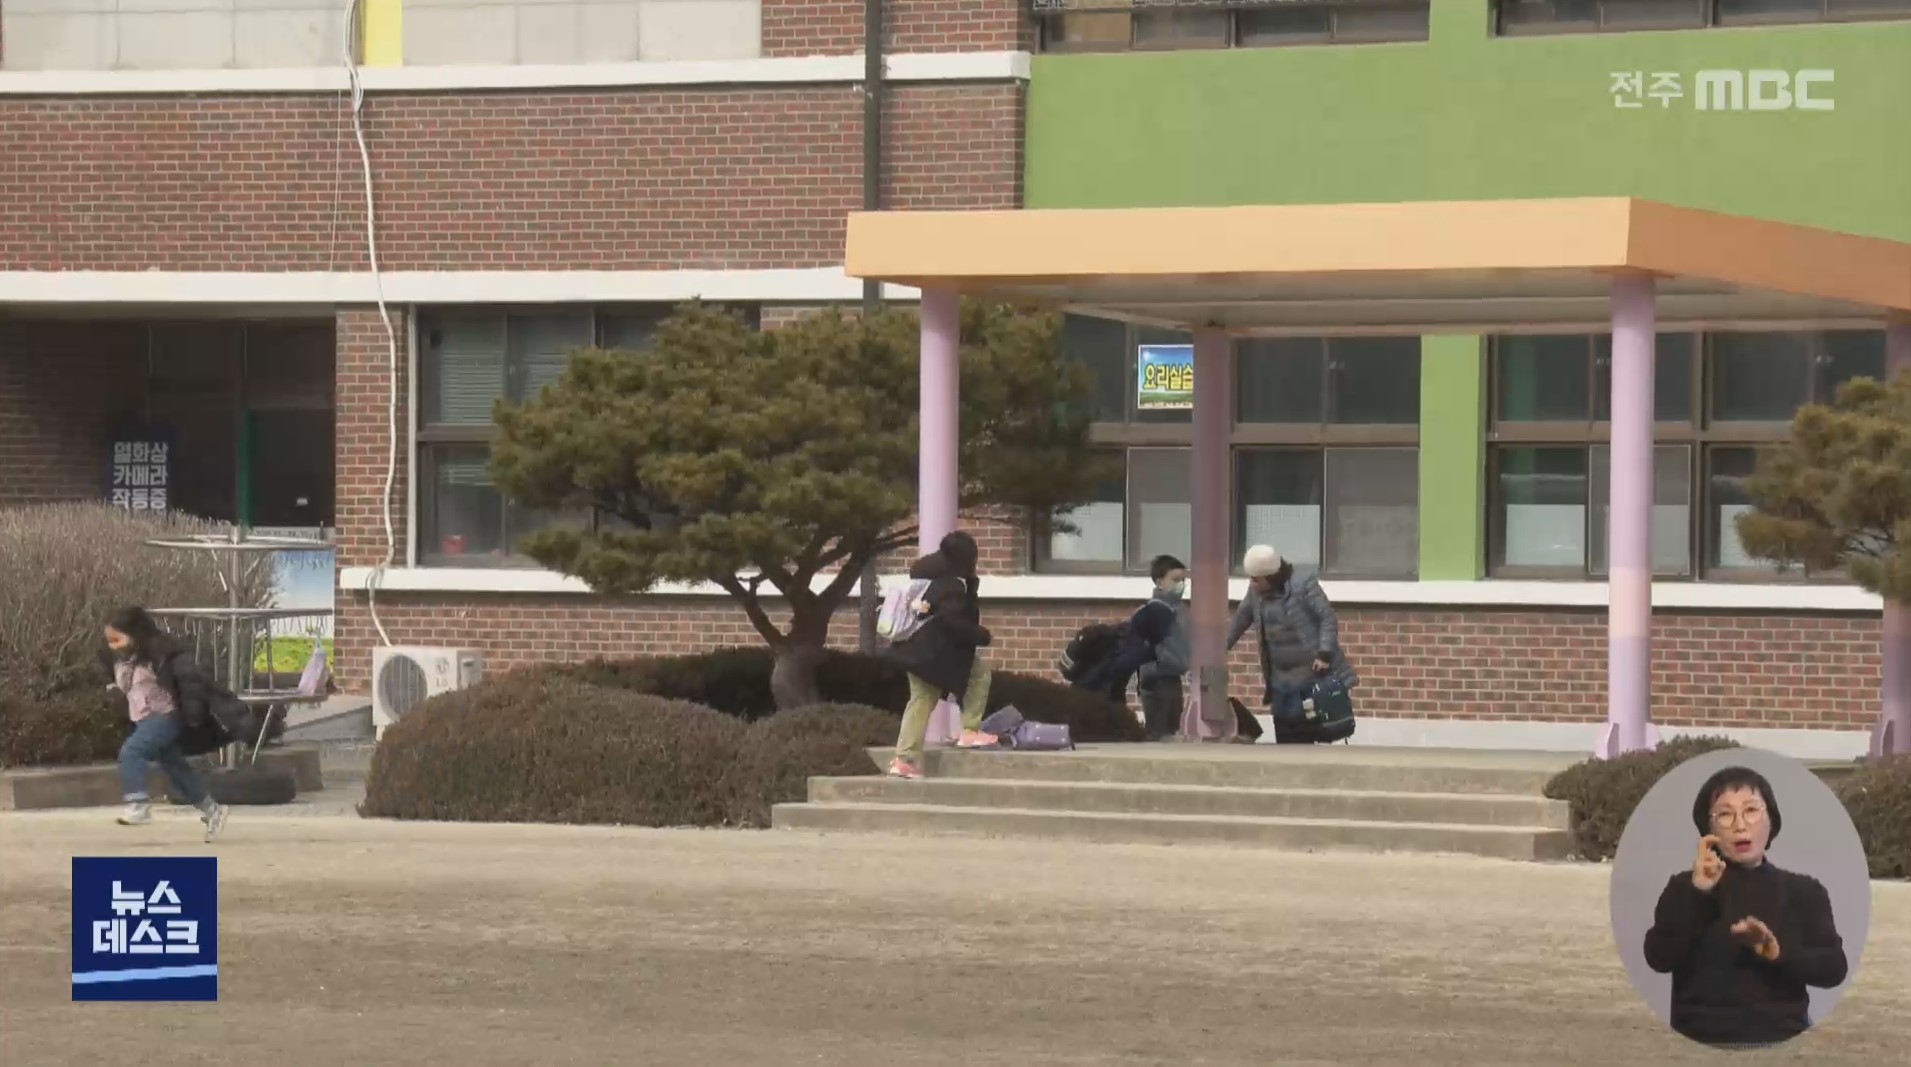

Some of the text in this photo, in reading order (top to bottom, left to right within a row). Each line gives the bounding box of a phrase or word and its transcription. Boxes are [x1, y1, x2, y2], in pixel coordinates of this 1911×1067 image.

[114, 441, 168, 463] 열화상
[113, 464, 168, 486] 카메라
[112, 488, 167, 509] 작동중
